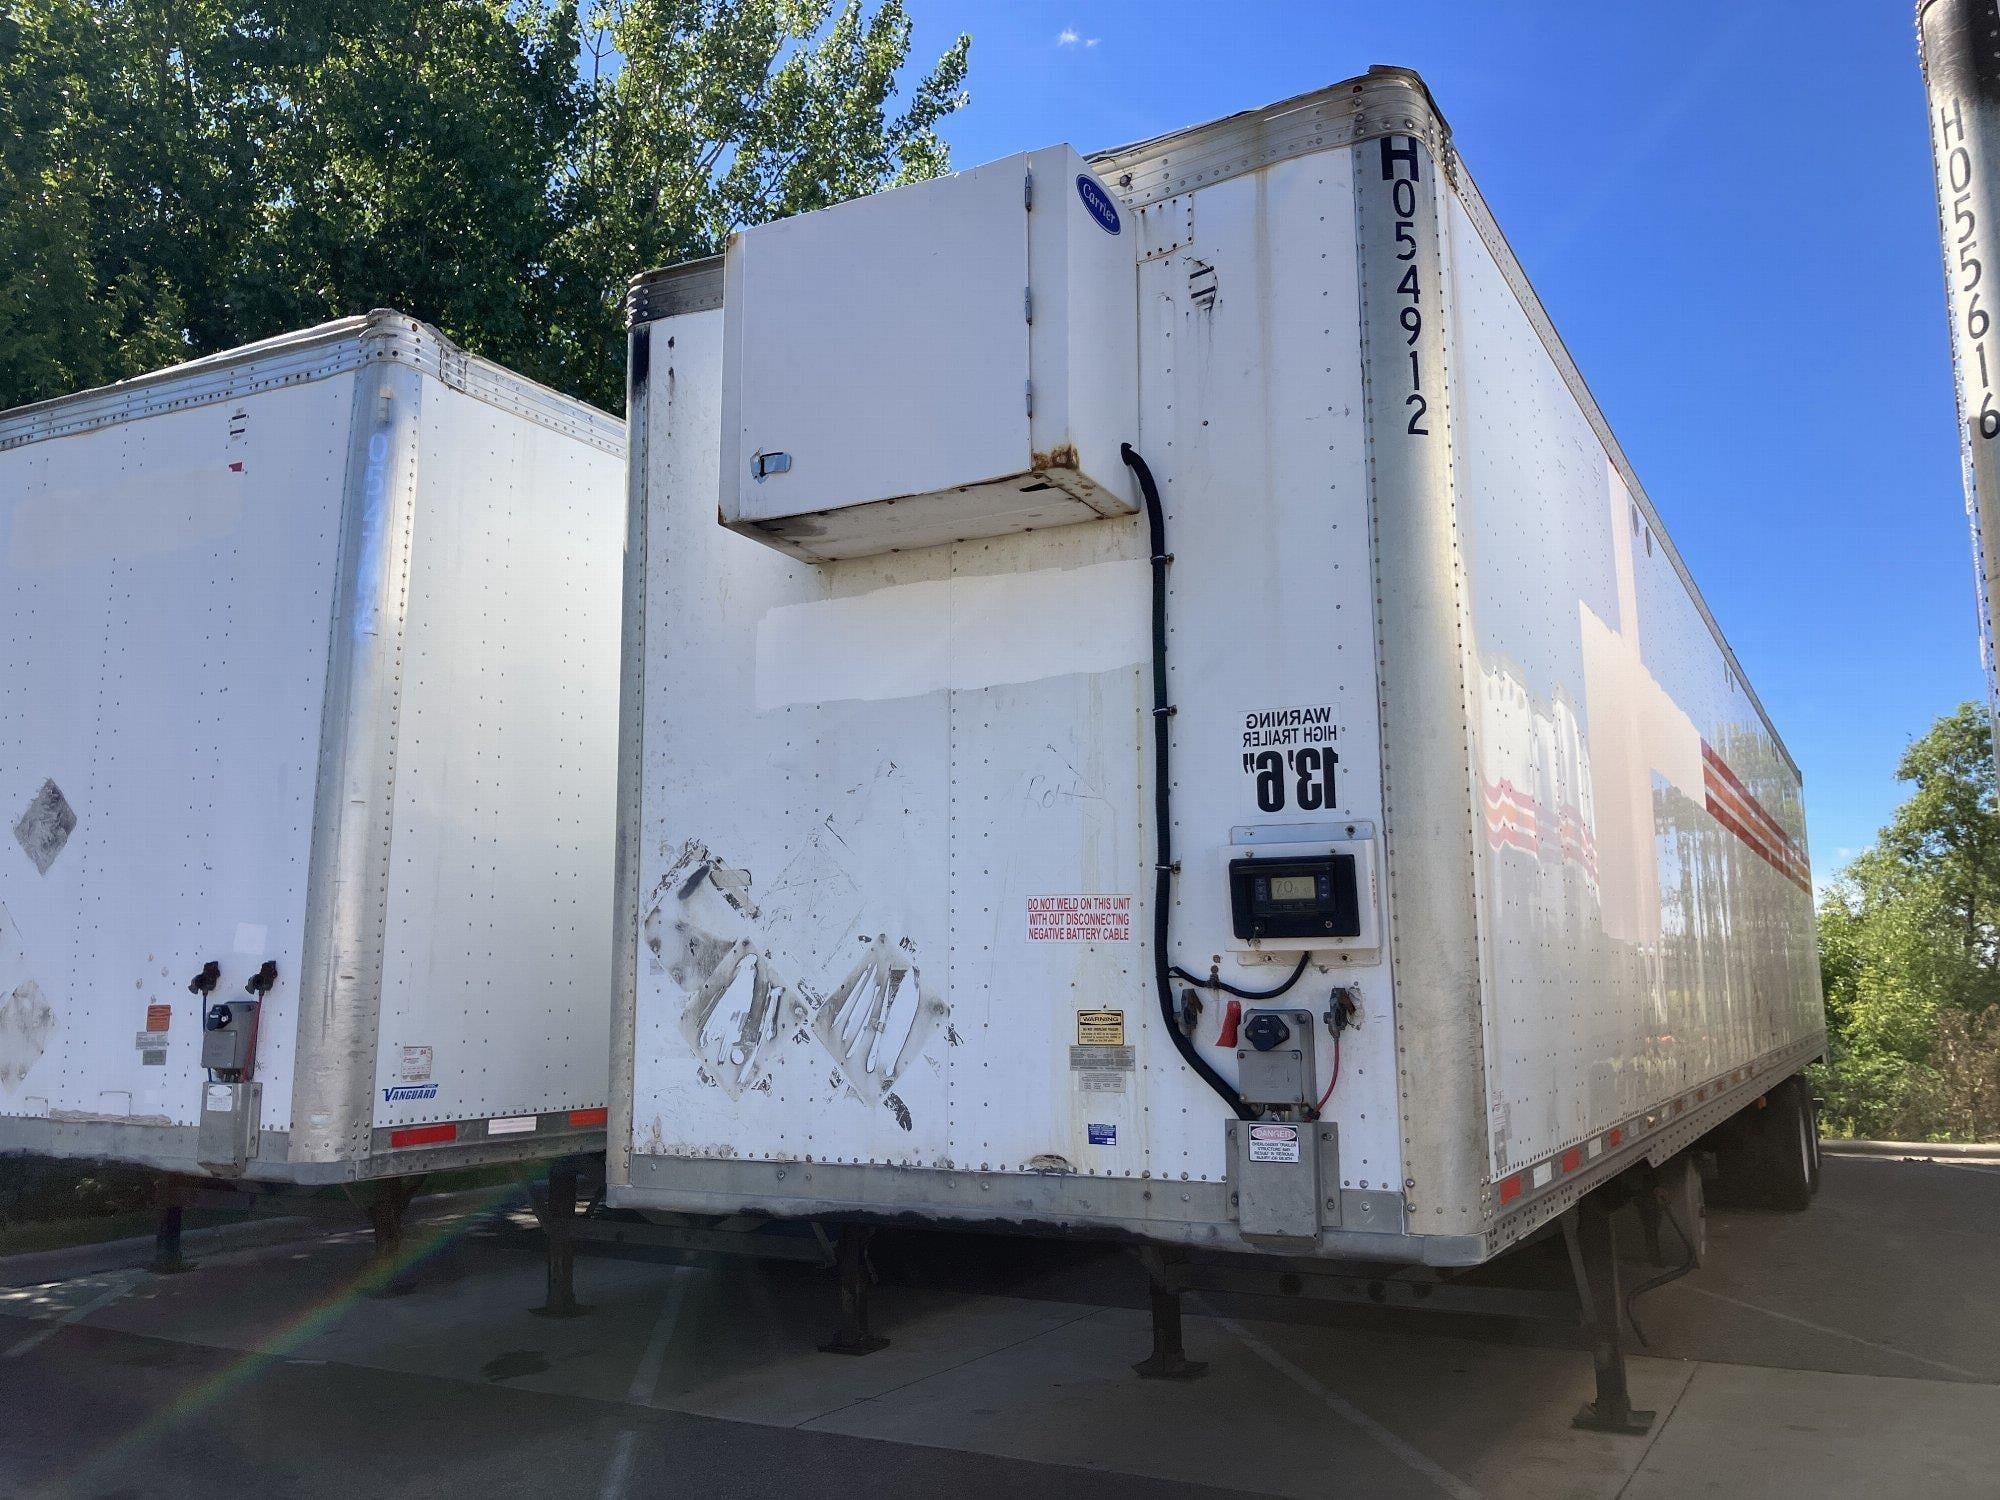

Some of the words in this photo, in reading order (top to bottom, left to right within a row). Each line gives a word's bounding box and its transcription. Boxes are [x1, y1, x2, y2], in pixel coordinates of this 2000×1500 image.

[1083, 183, 1115, 224] Carrier
[1941, 97, 2000, 440] H055616
[1380, 136, 1429, 436] H054912
[1028, 898, 1038, 909] DO
[1040, 898, 1055, 909] NOT
[1057, 898, 1078, 910] WELD
[1080, 898, 1091, 909] ON
[1094, 898, 1111, 909] THIS
[1113, 898, 1130, 909] UNIT
[1030, 913, 1047, 925] WITH
[1049, 913, 1064, 925] OUT
[1066, 913, 1129, 925] DISCONNECTING
[1029, 928, 1064, 940] NEGATIVE
[1066, 928, 1101, 940] BATTERY
[1103, 928, 1129, 940] CABLE
[382, 1086, 437, 1101] VANGUARD
[1256, 1129, 1291, 1138] DANGER
